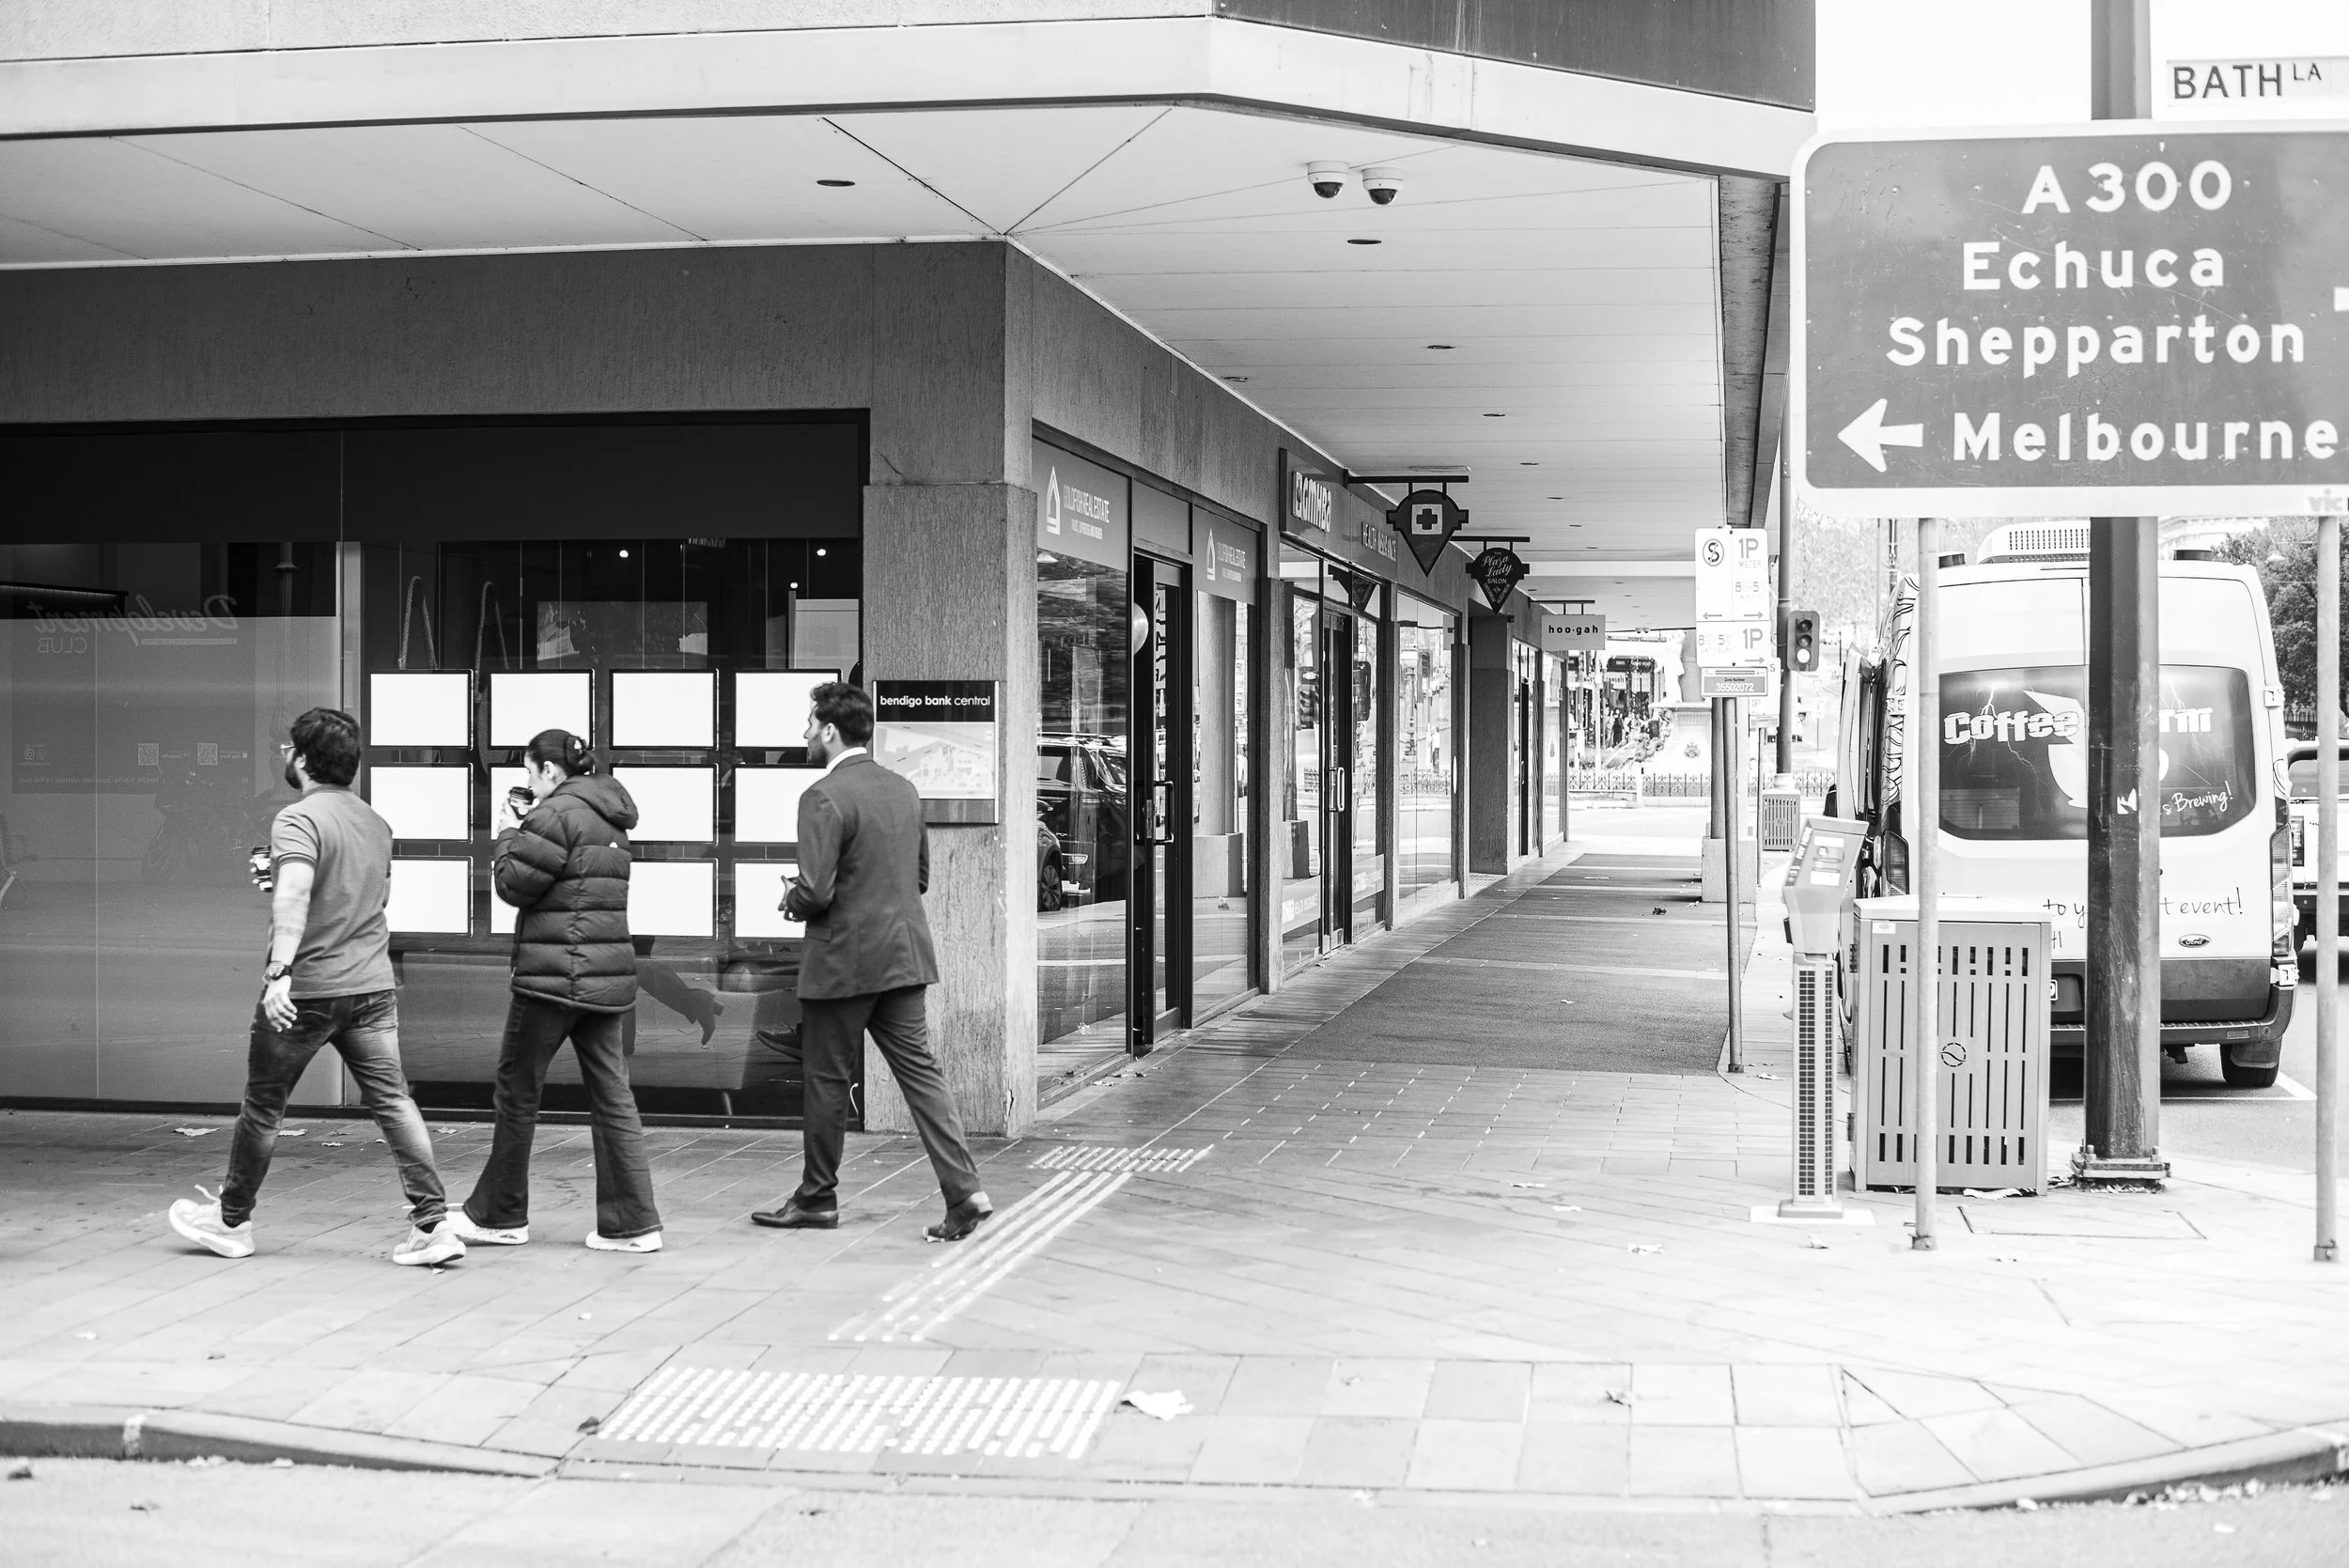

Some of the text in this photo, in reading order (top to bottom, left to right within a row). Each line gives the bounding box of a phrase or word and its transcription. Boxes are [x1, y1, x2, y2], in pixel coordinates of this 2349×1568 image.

[2172, 62, 2323, 100] BATH LA
[1962, 241, 2224, 290] Echuca
[1885, 313, 2305, 379] Shepparton
[1952, 411, 2339, 461] Melbourne
[2308, 489, 2349, 512] vic
[1482, 555, 1510, 568] Plaza
[1738, 537, 1759, 559] 1P
[1486, 564, 1513, 577] Lady
[1742, 628, 1764, 649] 1P
[879, 695, 990, 707] bendigo bank central
[1943, 710, 2079, 745] Coffee
[2170, 780, 2233, 814] Brewing!
[2179, 887, 2244, 915] event!
